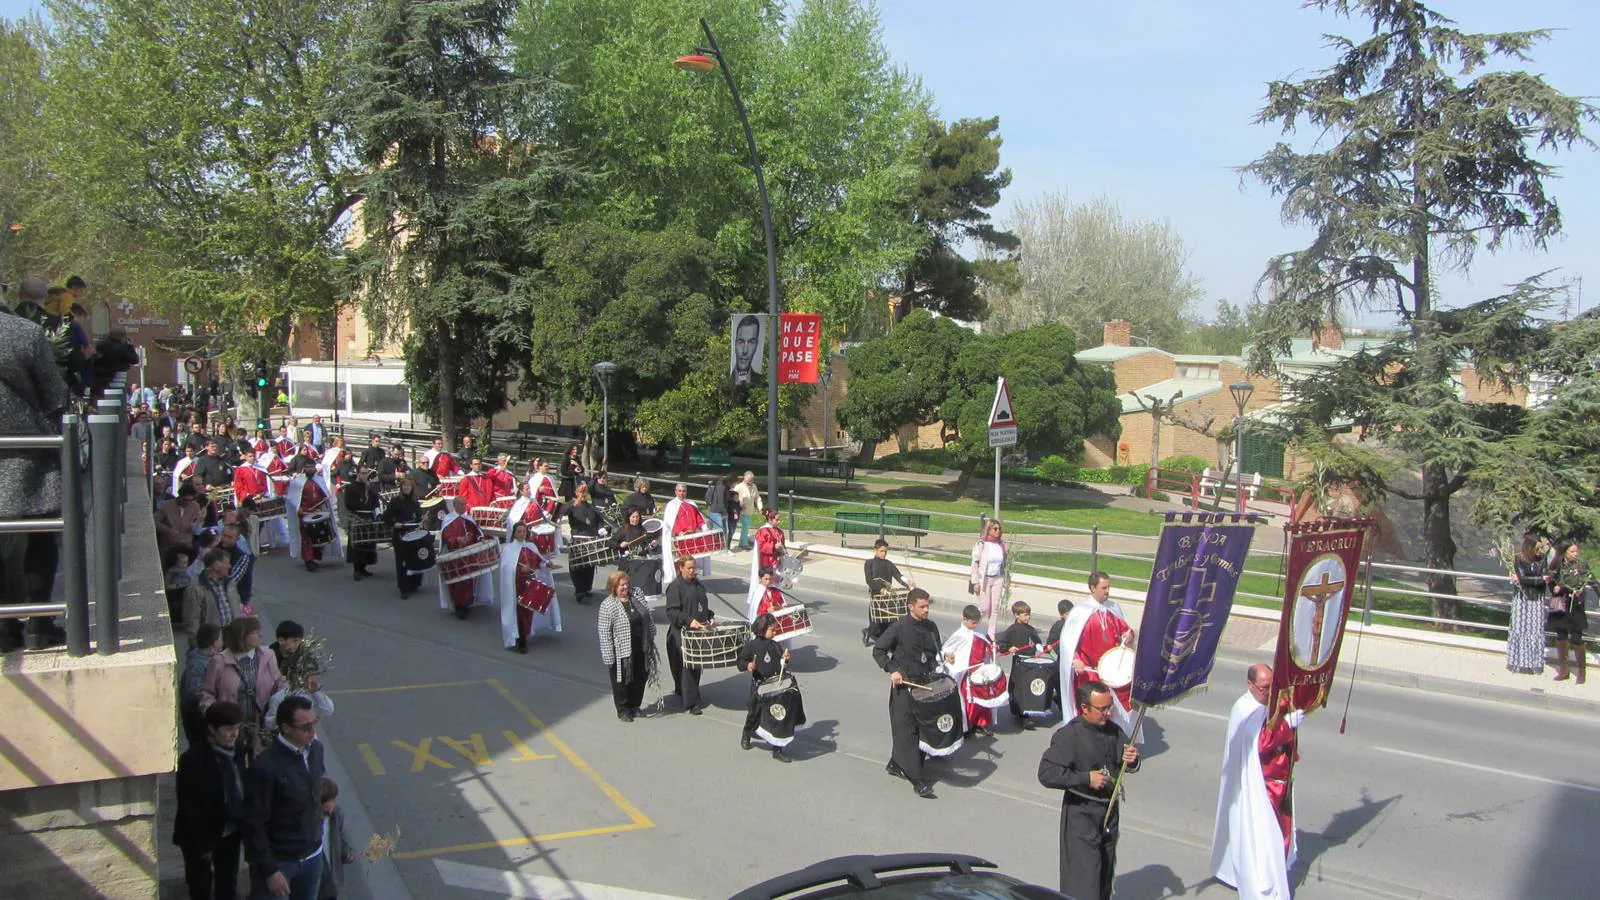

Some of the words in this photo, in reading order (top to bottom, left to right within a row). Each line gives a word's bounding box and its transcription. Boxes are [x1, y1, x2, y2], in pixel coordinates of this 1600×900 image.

[784, 322, 816, 333] HAZ
[782, 336, 814, 348] QUE
[782, 351, 813, 363] PASE
[357, 730, 556, 775] TAXI
